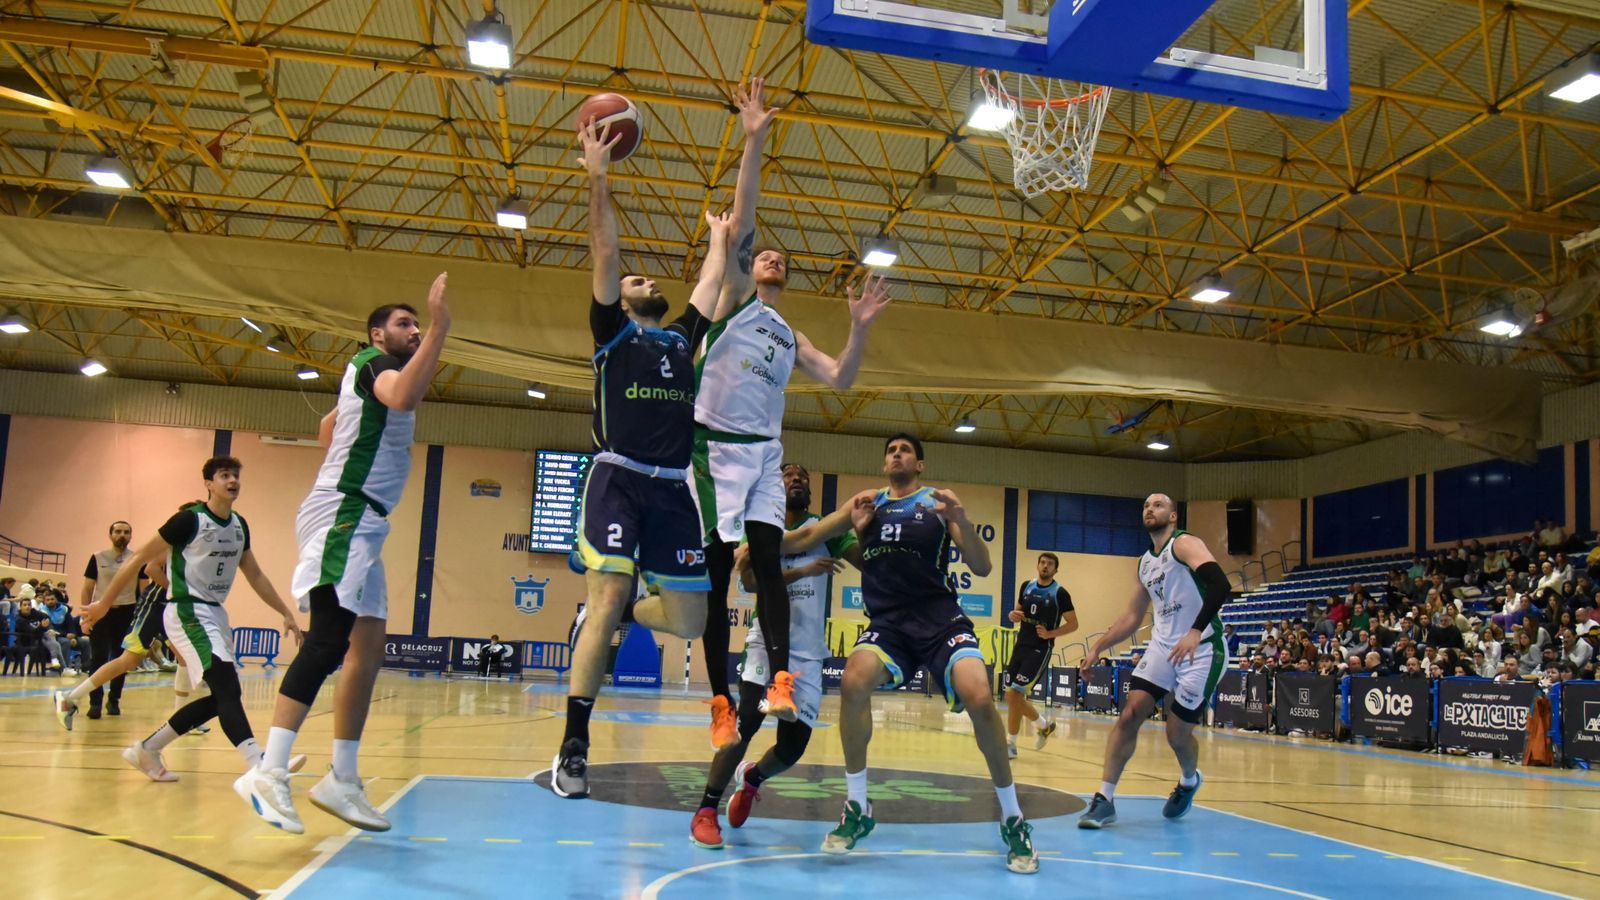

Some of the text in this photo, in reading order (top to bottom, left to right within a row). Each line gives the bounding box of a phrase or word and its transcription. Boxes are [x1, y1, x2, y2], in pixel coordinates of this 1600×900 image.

[764, 345, 775, 364] 3
[660, 354, 674, 379] 2
[607, 523, 623, 548] 2
[880, 523, 902, 542] 21
[1030, 603, 1038, 615] 0
[401, 643, 443, 653] DELACRUZ
[1384, 686, 1413, 717] ice
[1289, 707, 1320, 719] ASESORES
[1460, 730, 1509, 741] PLAZA ANDALUCÍA
